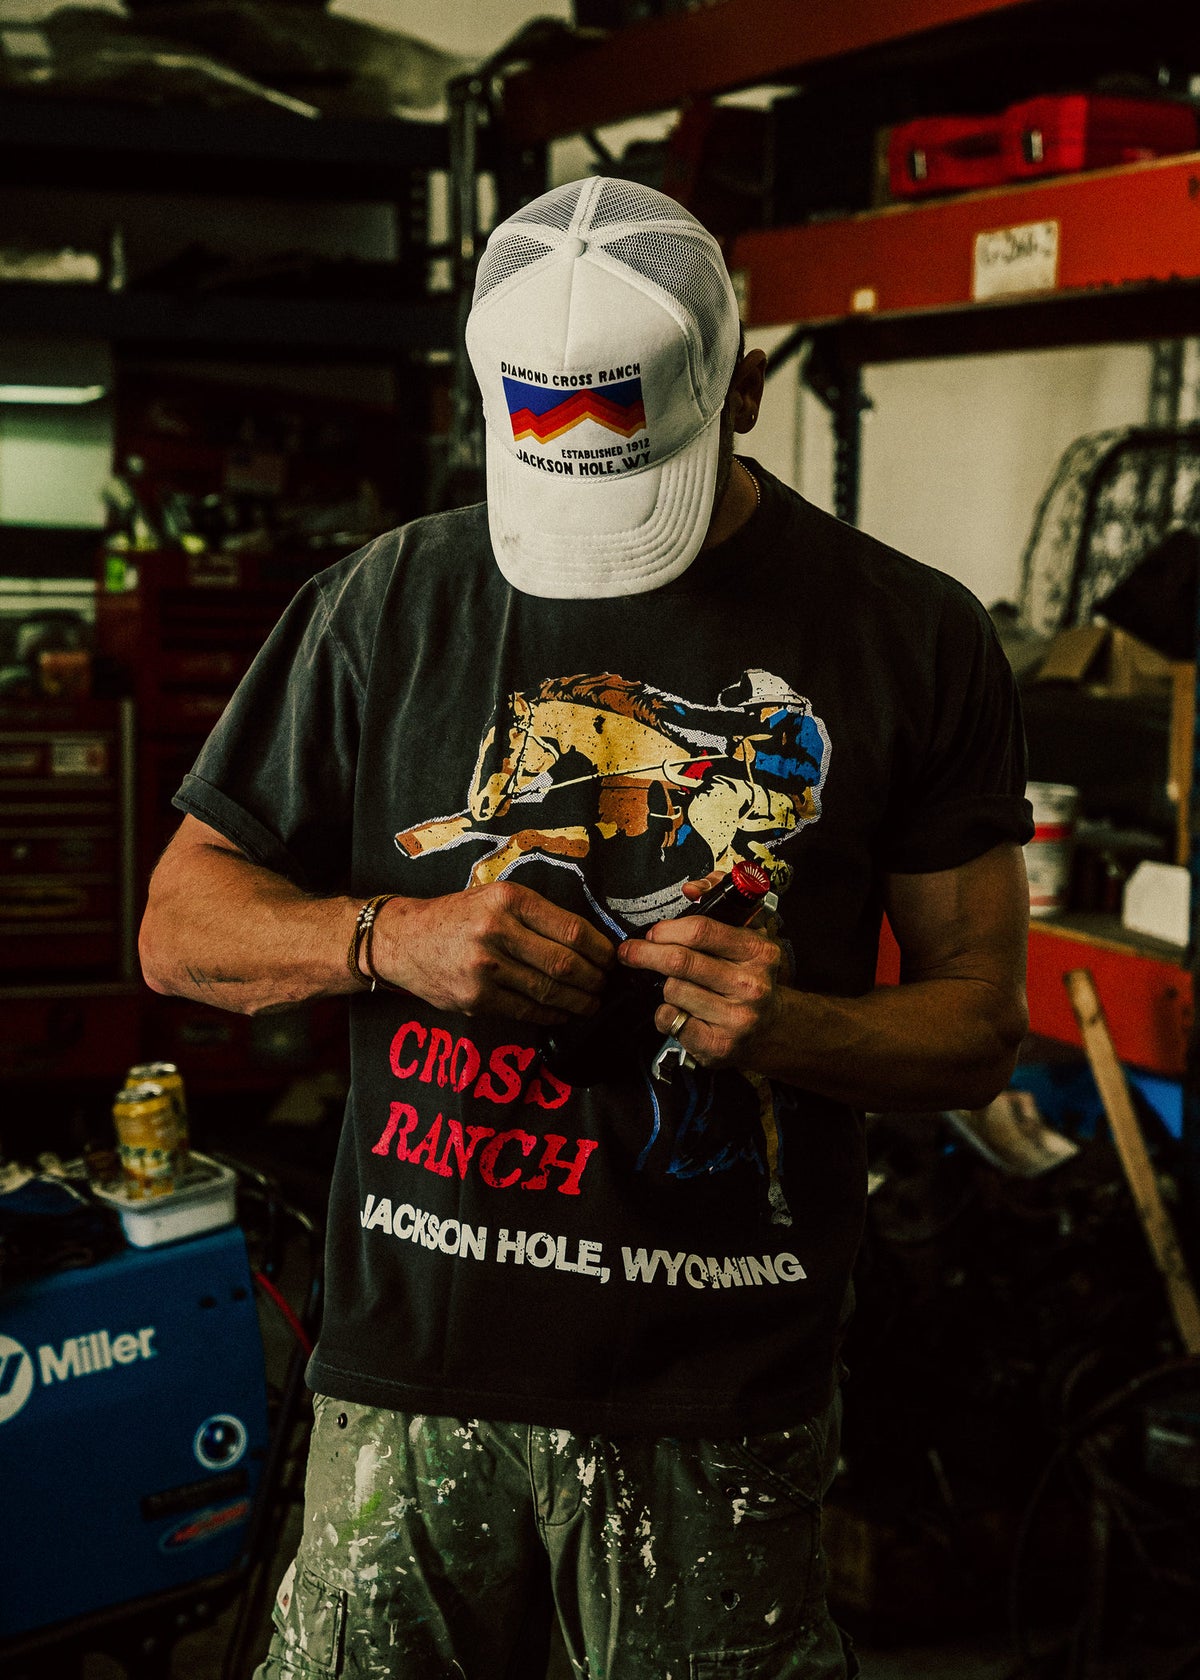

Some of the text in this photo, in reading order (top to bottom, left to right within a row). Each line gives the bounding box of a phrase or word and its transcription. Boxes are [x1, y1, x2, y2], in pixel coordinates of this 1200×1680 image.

[501, 361, 641, 387] DIAMOND CROSS RANCH
[516, 449, 651, 476] JACKSON HOLE, WY
[561, 437, 650, 459] ESTABLISHED 1912
[370, 1100, 599, 1196] RANCH
[359, 1193, 808, 1290] JACKSON HOLE, WYOMING
[37, 1325, 156, 1387] Miller
